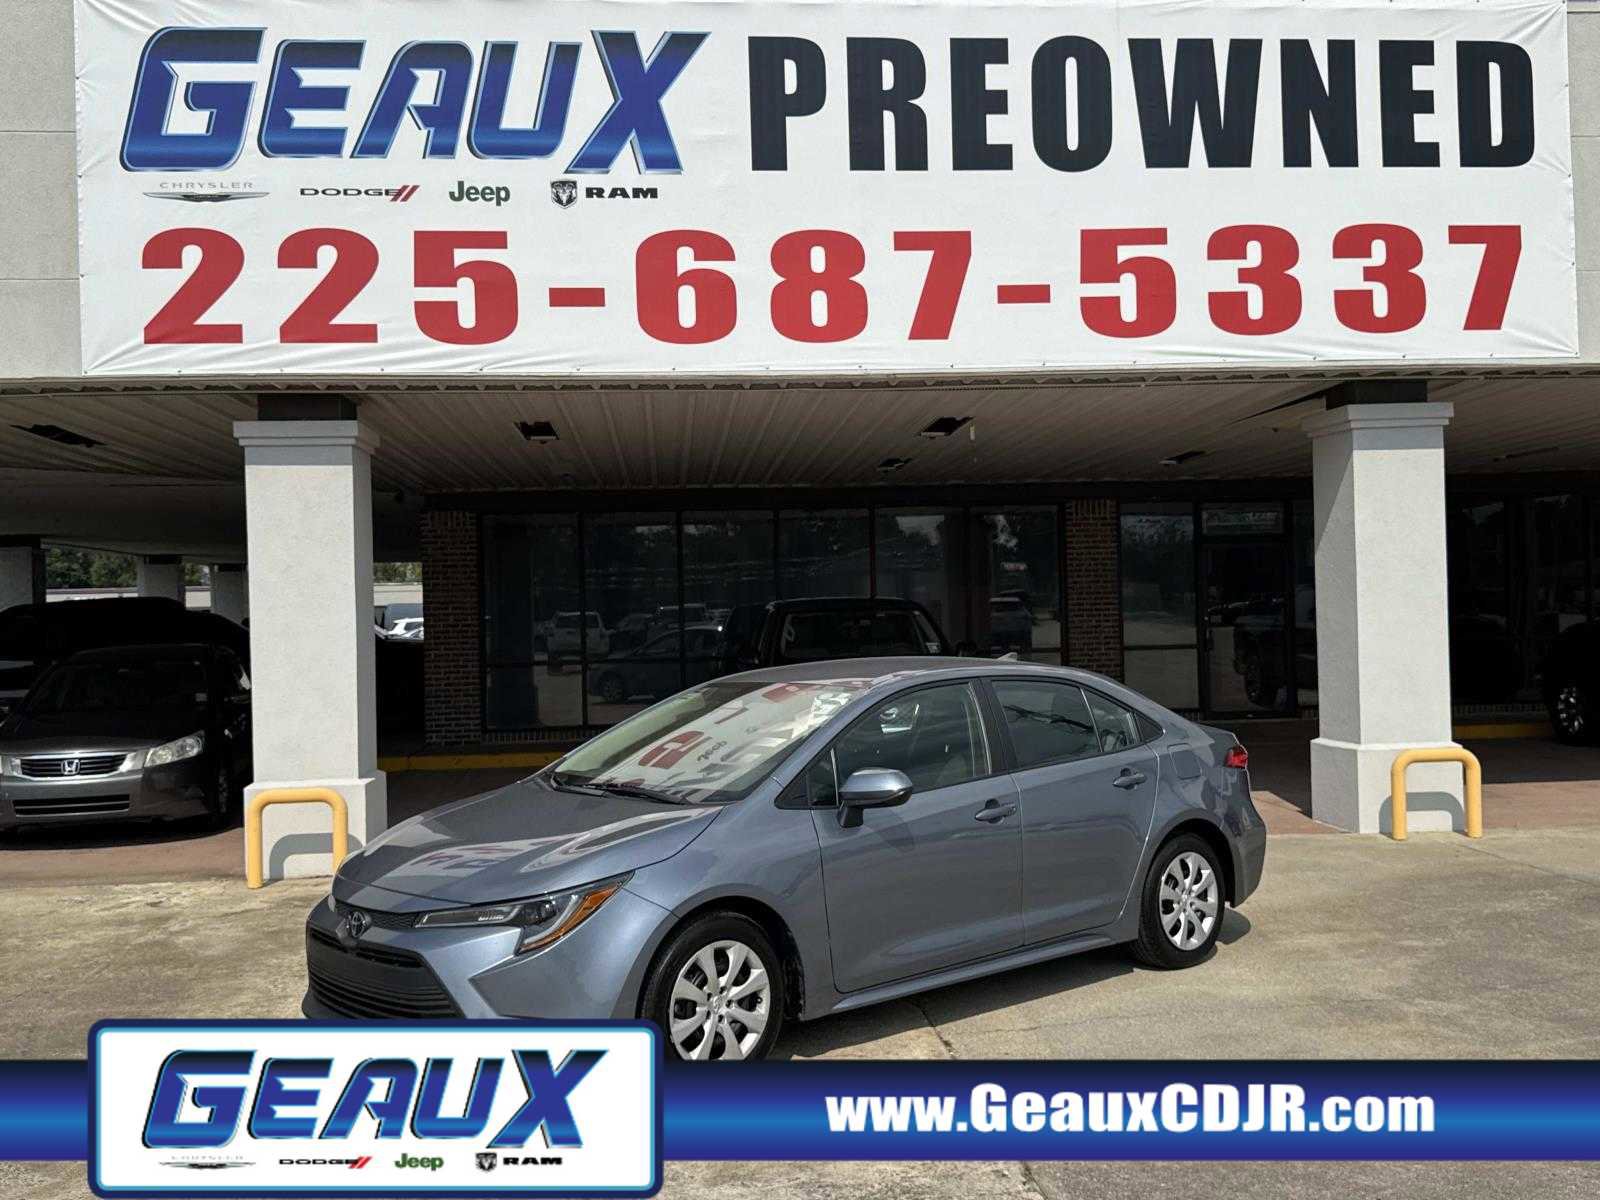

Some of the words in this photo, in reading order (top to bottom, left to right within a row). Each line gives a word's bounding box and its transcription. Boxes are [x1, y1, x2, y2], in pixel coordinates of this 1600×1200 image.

[119, 26, 711, 175] GEAUX
[748, 35, 1535, 172] PREOWNED
[300, 187, 402, 196] DODGE
[449, 181, 511, 206] Jeep
[585, 187, 658, 199] RAM
[143, 224, 1521, 344] 225-687-5337
